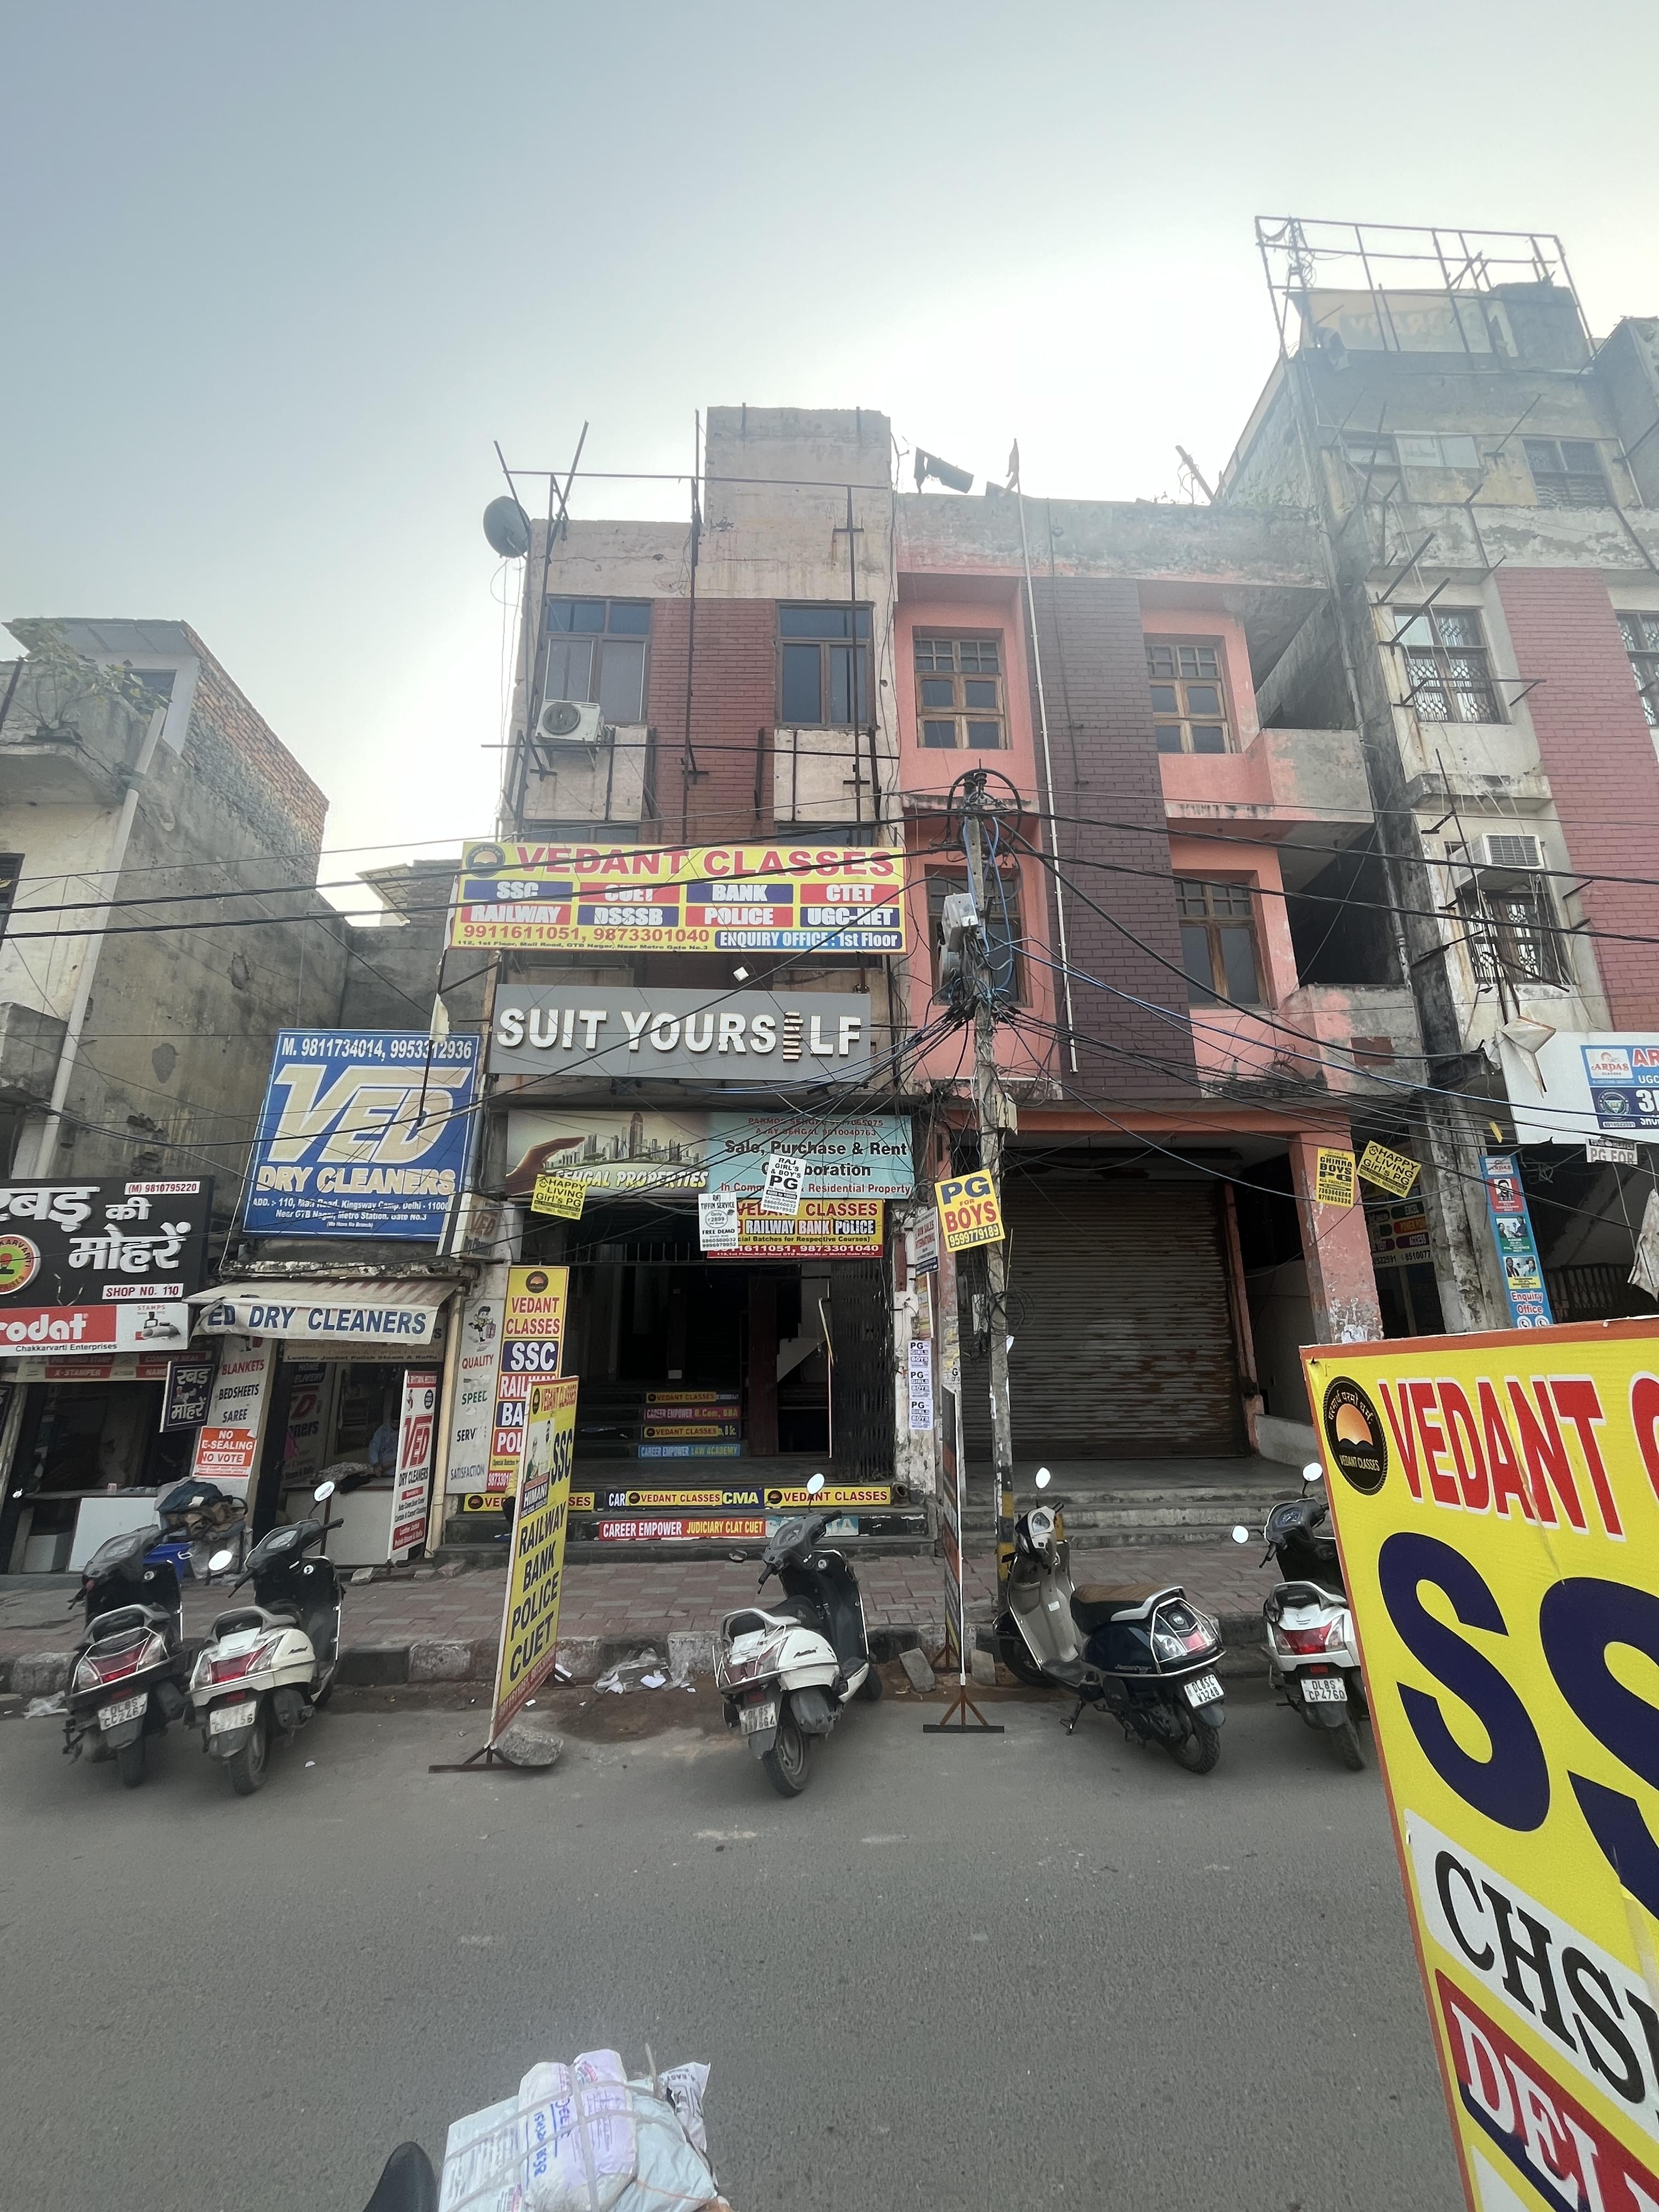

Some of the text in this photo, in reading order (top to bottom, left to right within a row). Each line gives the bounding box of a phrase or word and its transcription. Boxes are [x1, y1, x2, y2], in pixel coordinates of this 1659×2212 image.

[516, 847, 689, 875] VEDANT
[703, 850, 894, 877] CLASSES
[496, 882, 540, 899] SSC
[712, 884, 768, 902] BANK
[826, 885, 874, 902] CTET
[471, 905, 561, 923] RAILWAY
[594, 907, 663, 926] DSSSB
[704, 907, 774, 925] POLICE
[808, 908, 893, 926] UGC-NET
[464, 925, 709, 943] 9911611051, 9873301040
[720, 932, 898, 947] ENQUIRY OFFICE 1st Floor
[497, 1008, 606, 1050] SUIT
[281, 1039, 471, 1061] M. 9811734014, 9953312936
[1591, 1063, 1629, 1072] ARDAS
[267, 1063, 472, 1164] VED
[724, 1140, 907, 1156] Sale, Purchase & Rent
[1590, 1148, 1607, 1161] PG
[1375, 1155, 1414, 1178] LIVING
[1379, 1148, 1418, 1170] HAPPY
[761, 1161, 871, 1176] Cboration
[775, 1163, 799, 1172] GIRL'S
[778, 1170, 801, 1178] BOY'S
[1320, 1163, 1352, 1175] BOYS
[1363, 1158, 1390, 1177] Girl's
[1392, 1172, 1410, 1185] PG
[256, 1166, 456, 1195] DRY CLEANERS
[616, 1170, 709, 1189] PROPERTIES
[769, 1175, 798, 1190] PG
[1319, 1171, 1352, 1182] PG
[128, 1182, 197, 1193] (M) 9810795220
[546, 1187, 583, 1199] LIVING
[549, 1179, 585, 1191] HAPPY
[721, 1183, 730, 1191] In
[808, 1183, 911, 1195] Residential Property
[940, 1176, 991, 1205] PG
[341, 1200, 376, 1211] Kingsway
[536, 1192, 582, 1207] Girl's PG
[105, 1197, 153, 1221] की
[275, 1210, 292, 1218] Near
[805, 1203, 878, 1216] CLASSES
[944, 1200, 997, 1233] BOYS
[746, 1220, 795, 1234] RAILWAY
[799, 1220, 830, 1234] BANK
[835, 1220, 874, 1234] POLICE
[949, 1224, 999, 1247] 9599779189
[69, 1222, 191, 1273] मोहरें
[106, 1285, 179, 1297] SHOP NO. 110
[1511, 1291, 1543, 1302] Enquiry
[512, 1297, 560, 1313] VEDANT
[1516, 1304, 1543, 1315] Office
[250, 1307, 426, 1335] DRY CLEANERS
[506, 1318, 560, 1335] CLASSES
[15, 1344, 117, 1352] Chakkarvarti Enterprises
[462, 1354, 495, 1369] QUALITY
[510, 1342, 555, 1372] SSC
[222, 1359, 264, 1375] BLANKETS
[219, 1384, 259, 1401] BEDSHEETS
[222, 1408, 248, 1423] SAREE
[219, 1430, 233, 1440] NO
[400, 1414, 433, 1470] VED
[201, 1440, 253, 1451] E-SEALING
[707, 1446, 737, 1455] ACADEMY
[218, 1454, 243, 1463] VOTE
[551, 1428, 573, 1486] SSC
[1339, 1454, 1380, 1472] VEDANT CLASSES
[1378, 1376, 1628, 1542] VEDANT
[408, 1467, 428, 1485] CLEANERS
[450, 1464, 485, 1481] SATISFACTION
[641, 1493, 720, 1503] VEDANT CLASSES
[723, 1492, 759, 1504] CMA
[783, 1491, 888, 1502] VEDANT CLASSES
[519, 1502, 566, 1558] RAILWAY
[603, 1523, 636, 1537] CAREER
[638, 1522, 682, 1536] EMPOWER
[686, 1522, 724, 1534] JUDICIARY
[725, 1521, 743, 1533] CLAT
[744, 1521, 764, 1533] CUET
[523, 1540, 556, 1593] BANK
[510, 1571, 558, 1641] POLICE
[510, 1611, 554, 1683] CUET
[1312, 1680, 1336, 1690] DL8S
[1308, 1690, 1344, 1701] CP4760
